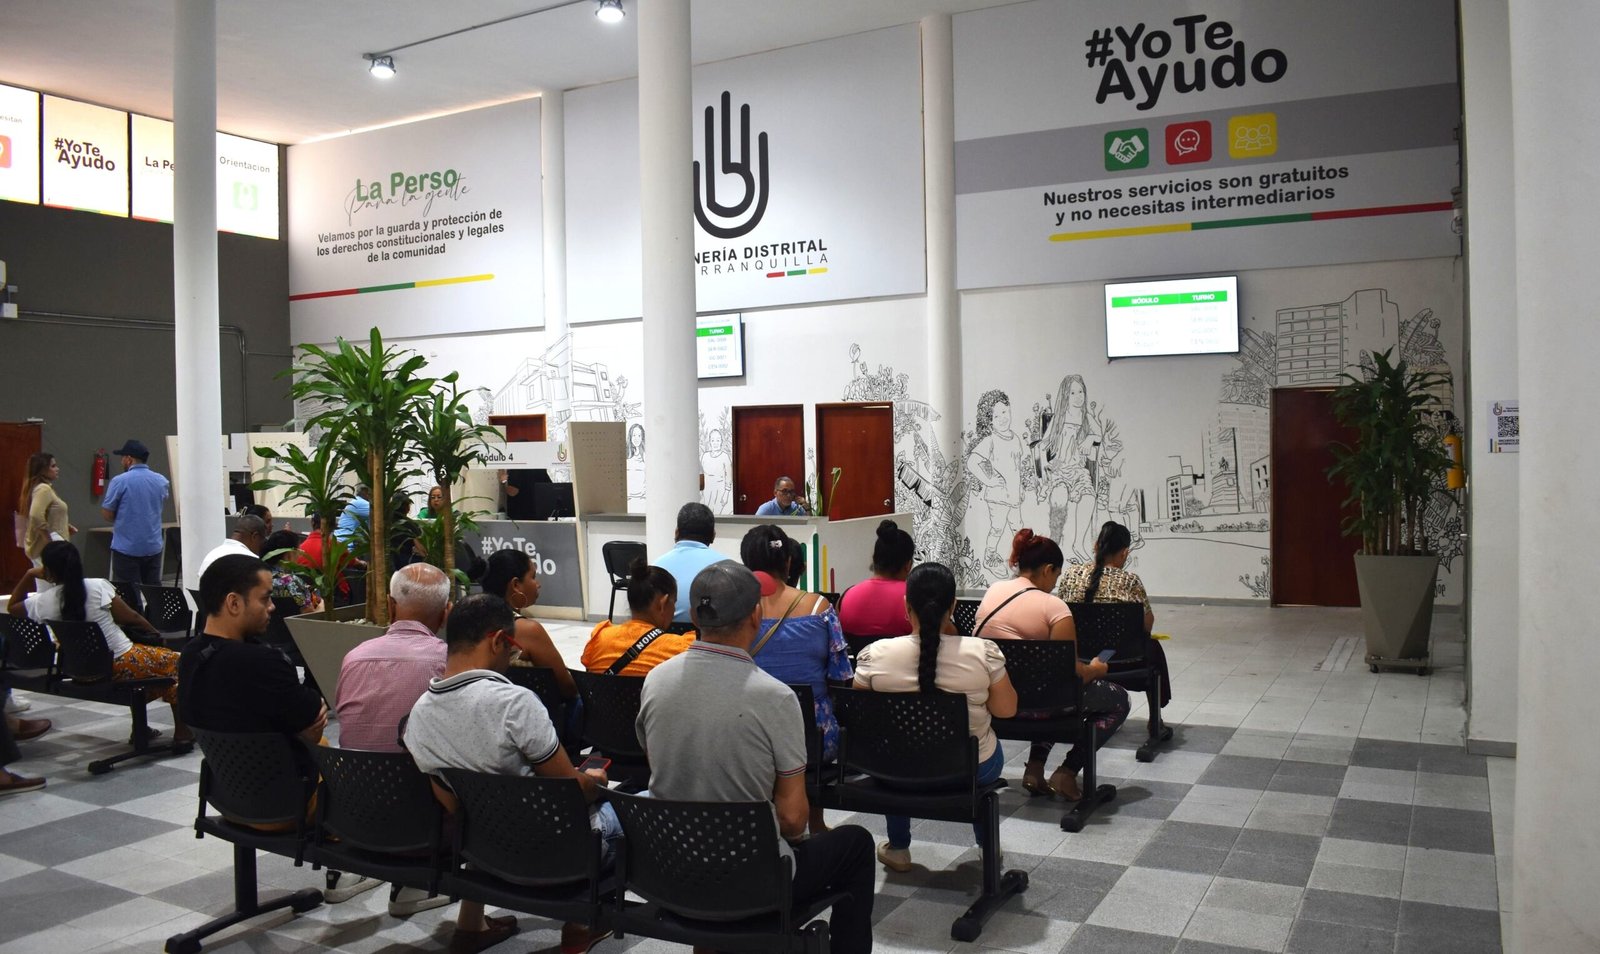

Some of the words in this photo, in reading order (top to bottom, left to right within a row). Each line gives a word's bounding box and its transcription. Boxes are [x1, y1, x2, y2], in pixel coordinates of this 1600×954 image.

[1095, 41, 1288, 111] Ayudo
[58, 148, 116, 171] Ayudo
[145, 156, 159, 168] La
[344, 185, 397, 226] Para
[402, 184, 420, 206] la
[422, 173, 471, 217] gente
[356, 179, 382, 202] La
[390, 169, 458, 196] Perso
[1043, 187, 1123, 206] Nuestros
[1128, 178, 1213, 198] servicios
[1218, 175, 1253, 190] son
[1258, 165, 1349, 189] gratuitos
[1055, 211, 1066, 226] y
[1071, 209, 1093, 221] no
[1098, 200, 1186, 219] necesitas
[1191, 186, 1336, 211] intermediarios
[316, 246, 330, 256] los
[332, 240, 375, 254] derechos
[376, 229, 457, 249] constitucionales
[458, 228, 465, 240] y
[467, 222, 505, 237] legales
[318, 230, 356, 243] Velamos
[357, 228, 374, 240] por
[376, 225, 385, 235] la
[387, 220, 421, 236] guarda
[422, 220, 430, 231] y
[431, 210, 487, 230] protección
[489, 208, 503, 220] de
[367, 252, 380, 262] de
[381, 250, 390, 261] la
[392, 243, 447, 260] comunidad
[744, 239, 828, 259] DISTRITAL
[701, 253, 828, 275] RRANQUILLA
[1192, 293, 1215, 302] TURNO
[509, 453, 515, 462] 4
